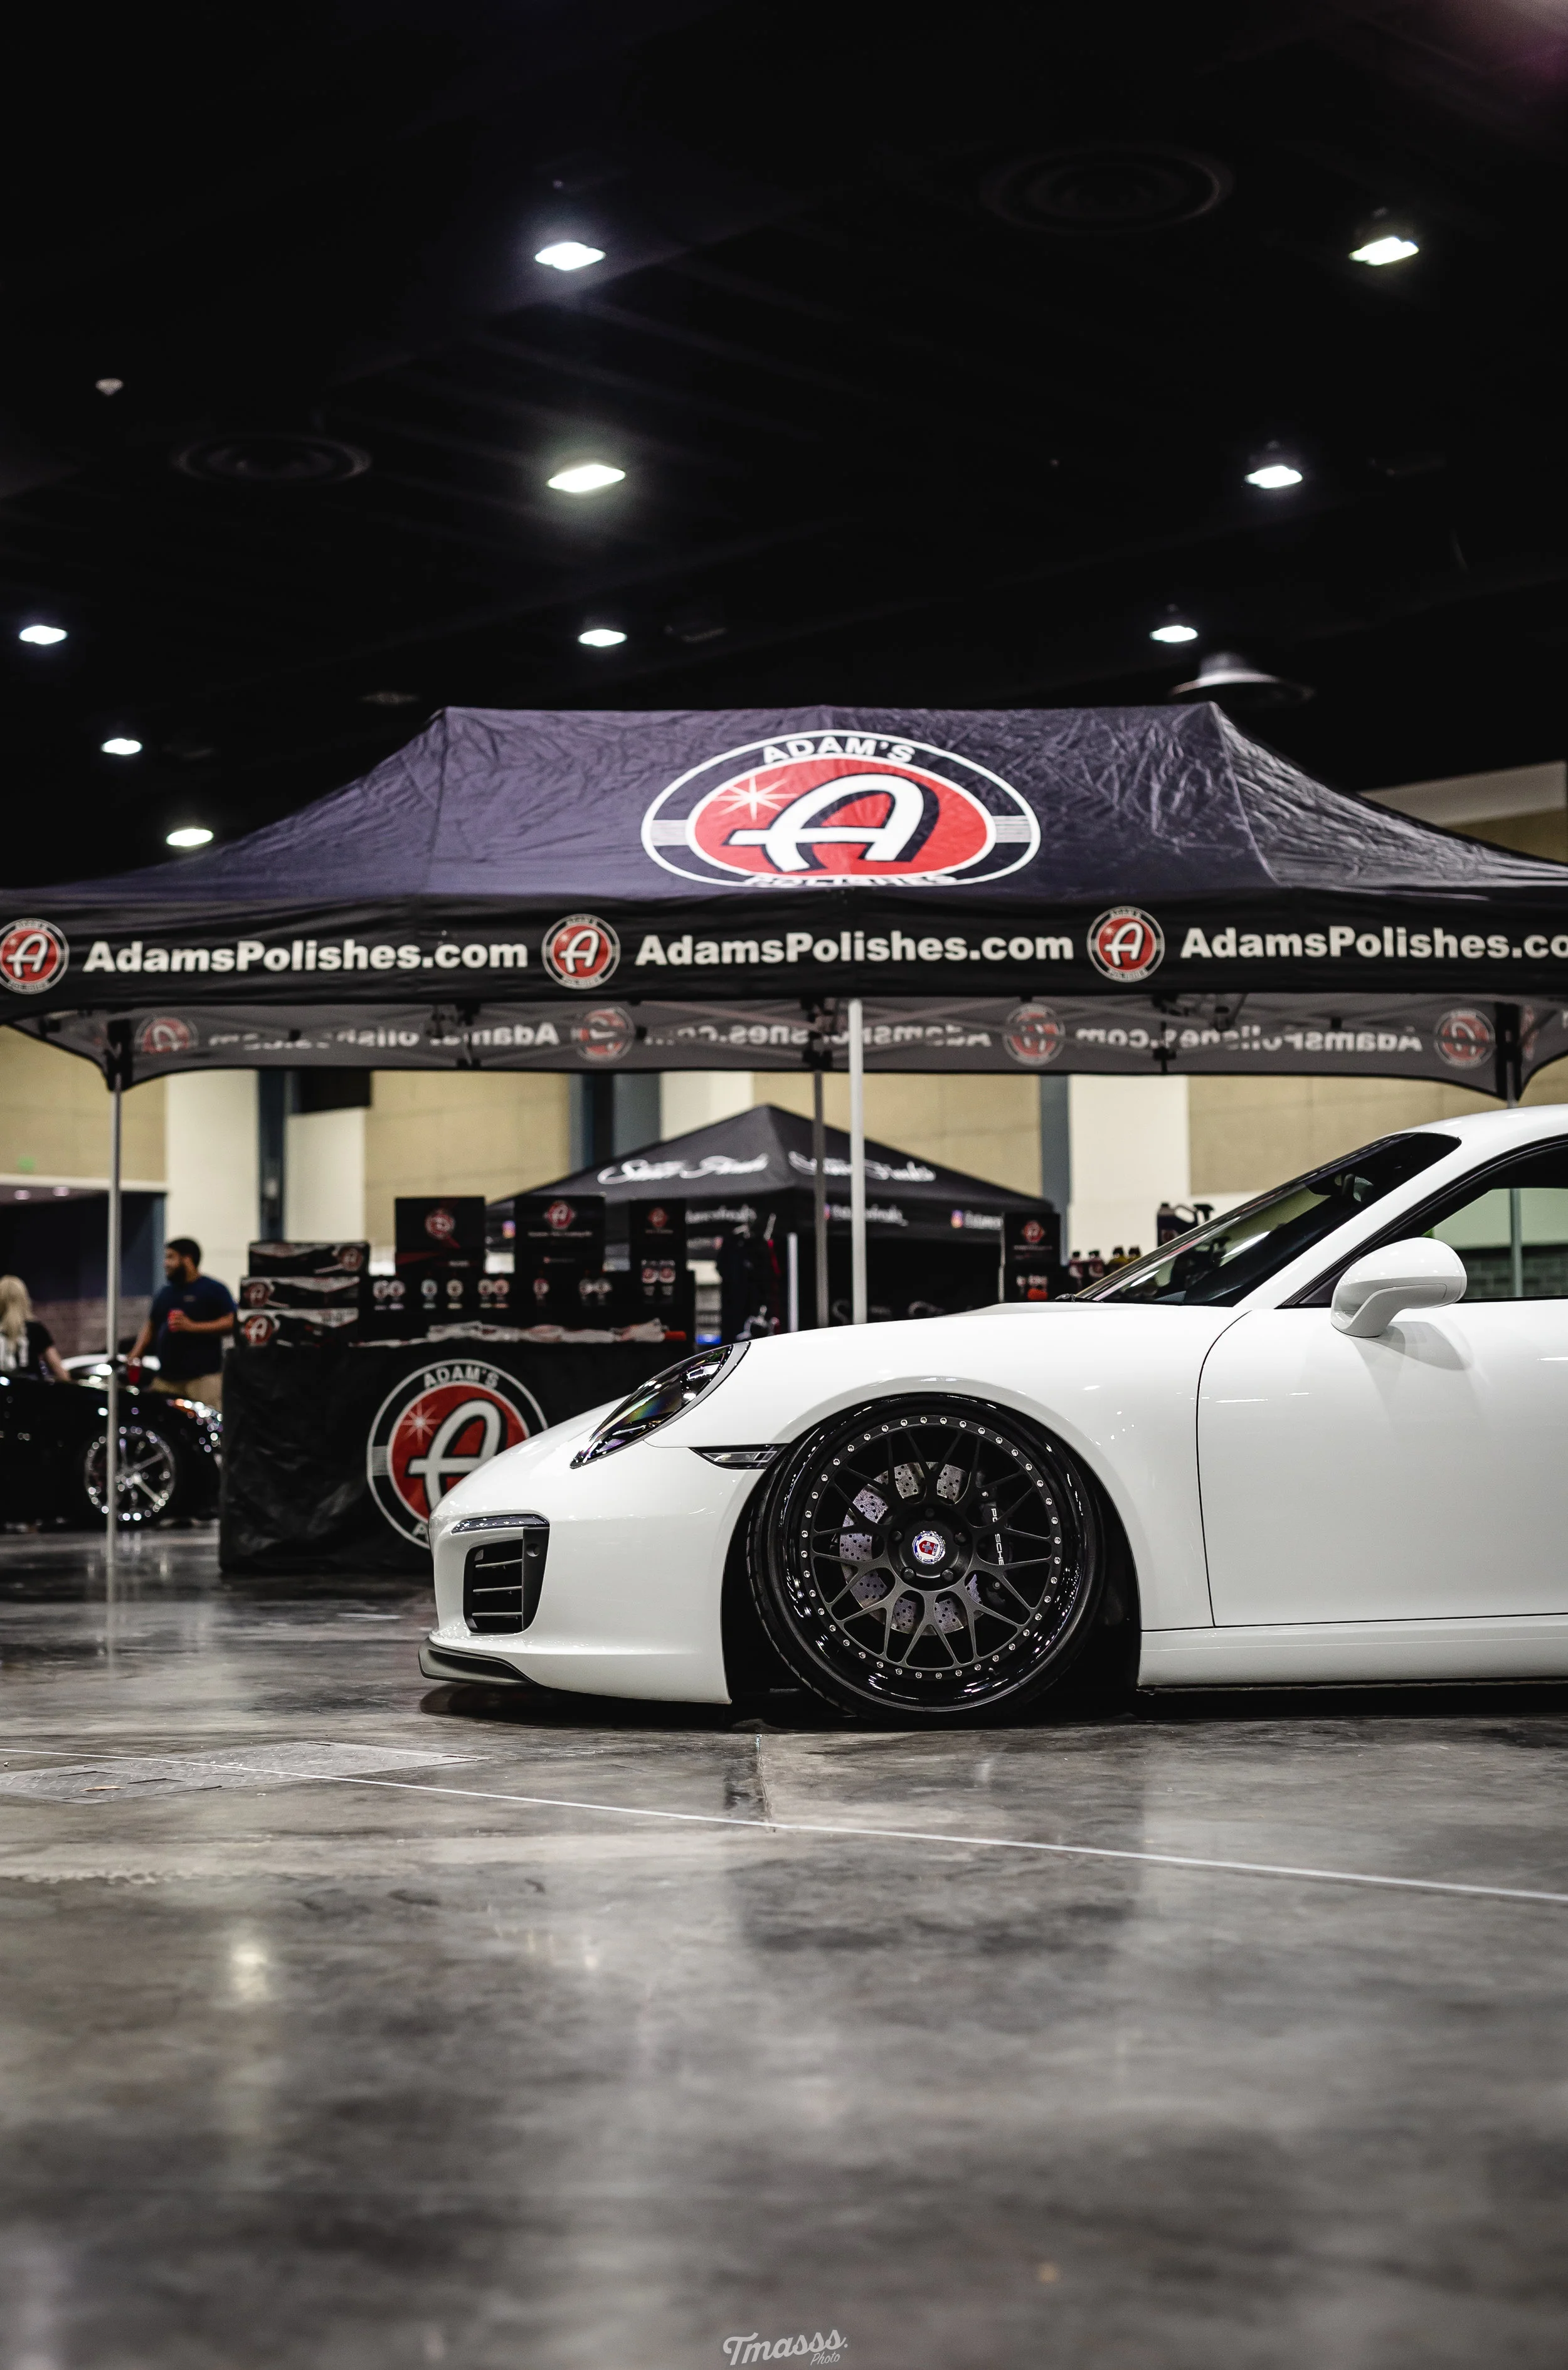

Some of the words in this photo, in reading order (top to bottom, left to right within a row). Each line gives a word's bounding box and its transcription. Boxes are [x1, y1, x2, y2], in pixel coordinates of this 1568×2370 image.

[762, 736, 916, 765] ADAM'S
[83, 938, 528, 972] AdamsPolishes.com
[635, 931, 1074, 966] AdamsPolishes.com
[423, 1364, 499, 1389] ADAM'S
[991, 1508, 1004, 1565] POSCHE
